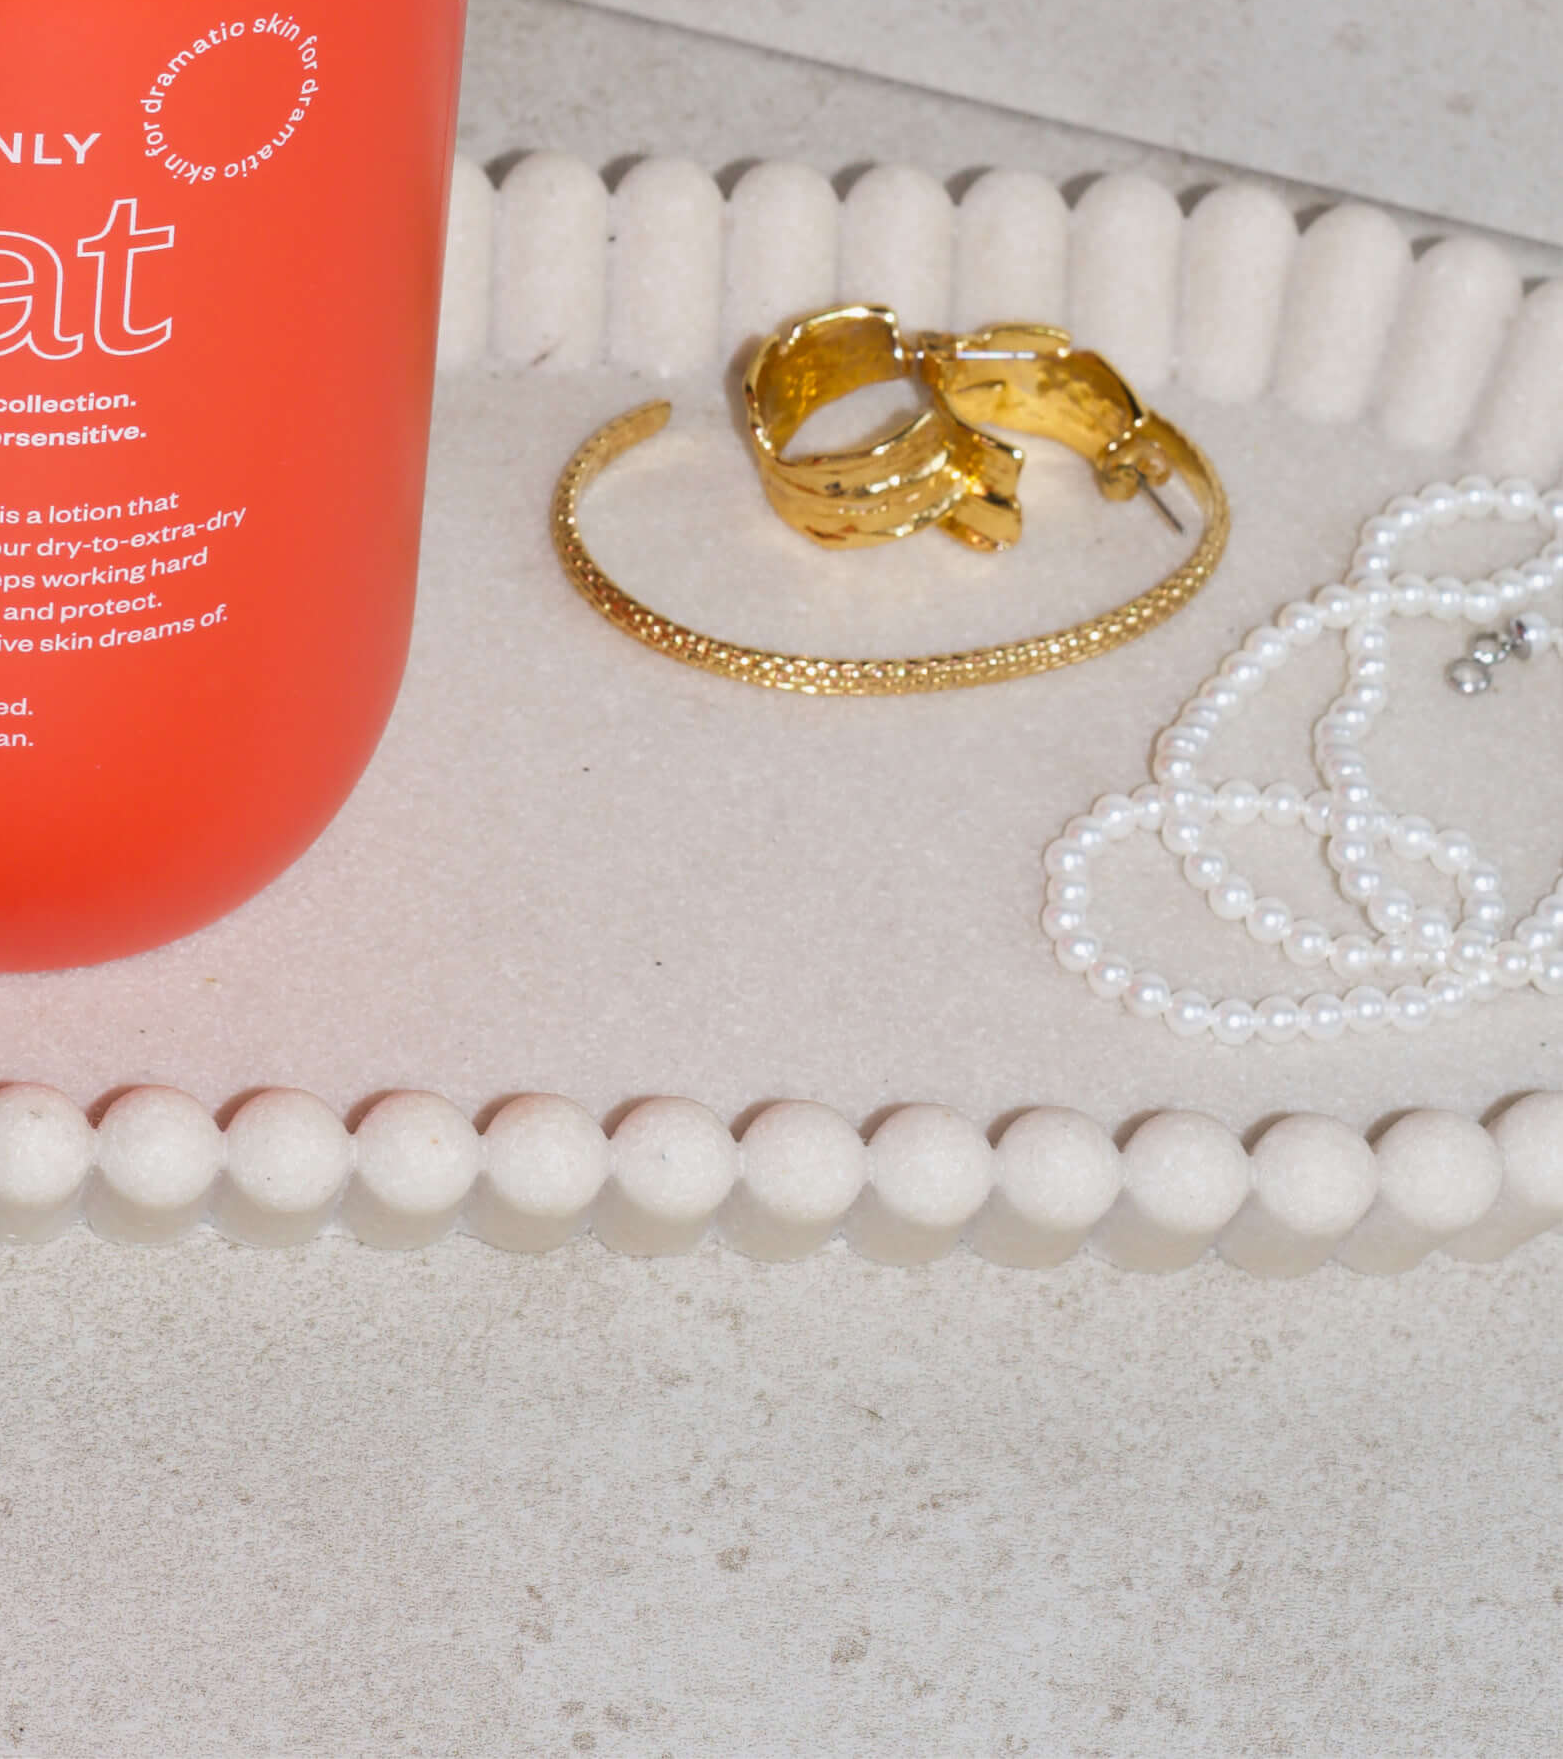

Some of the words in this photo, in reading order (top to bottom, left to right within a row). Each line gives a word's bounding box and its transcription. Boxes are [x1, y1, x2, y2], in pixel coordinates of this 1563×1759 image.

[251, 12, 301, 42] skin
[297, 34, 318, 71] for
[142, 121, 169, 158] for
[163, 153, 217, 185] skin
[25, 510, 43, 525] a
[48, 502, 122, 524] lotion
[126, 491, 180, 517] that
[36, 506, 247, 560] dry-to-extra-dry
[41, 564, 147, 589] working
[150, 545, 209, 577] hard
[2, 601, 55, 621] and
[59, 591, 163, 625] protect.
[39, 631, 94, 653] skin
[98, 617, 196, 648] dreams
[199, 603, 228, 628] of.
